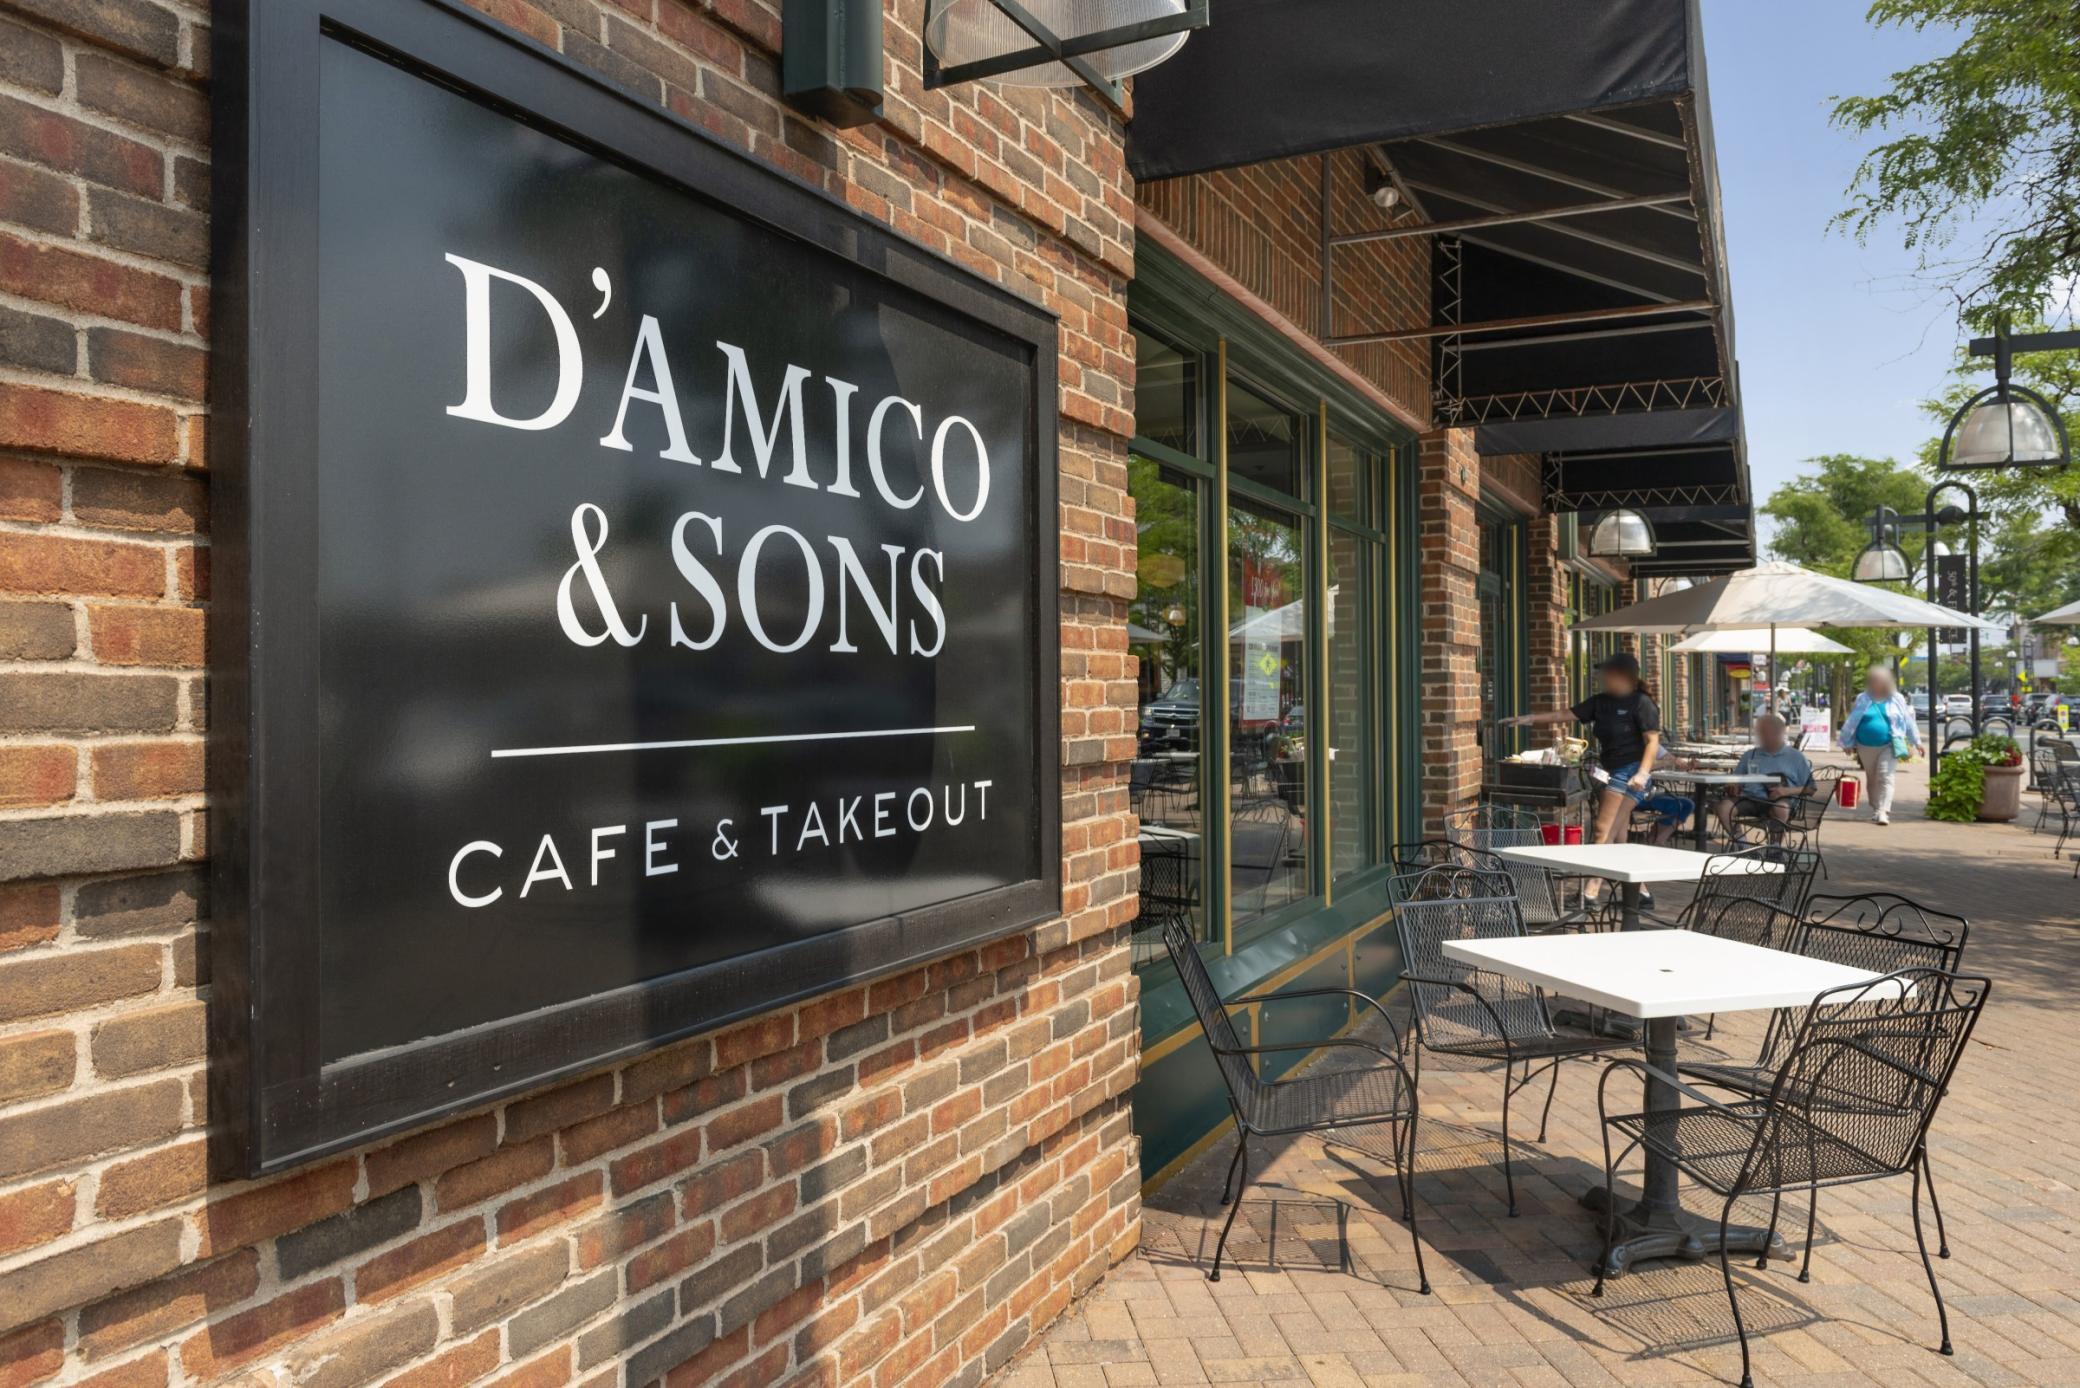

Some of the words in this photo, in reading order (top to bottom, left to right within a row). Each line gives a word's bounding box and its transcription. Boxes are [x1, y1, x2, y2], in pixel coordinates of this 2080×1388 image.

[444, 251, 992, 523] D’AMICO
[556, 502, 648, 648] &
[670, 511, 947, 658] SONS
[448, 818, 680, 908] CAFE
[711, 818, 740, 861] &
[760, 780, 993, 856] TAKEOUT
